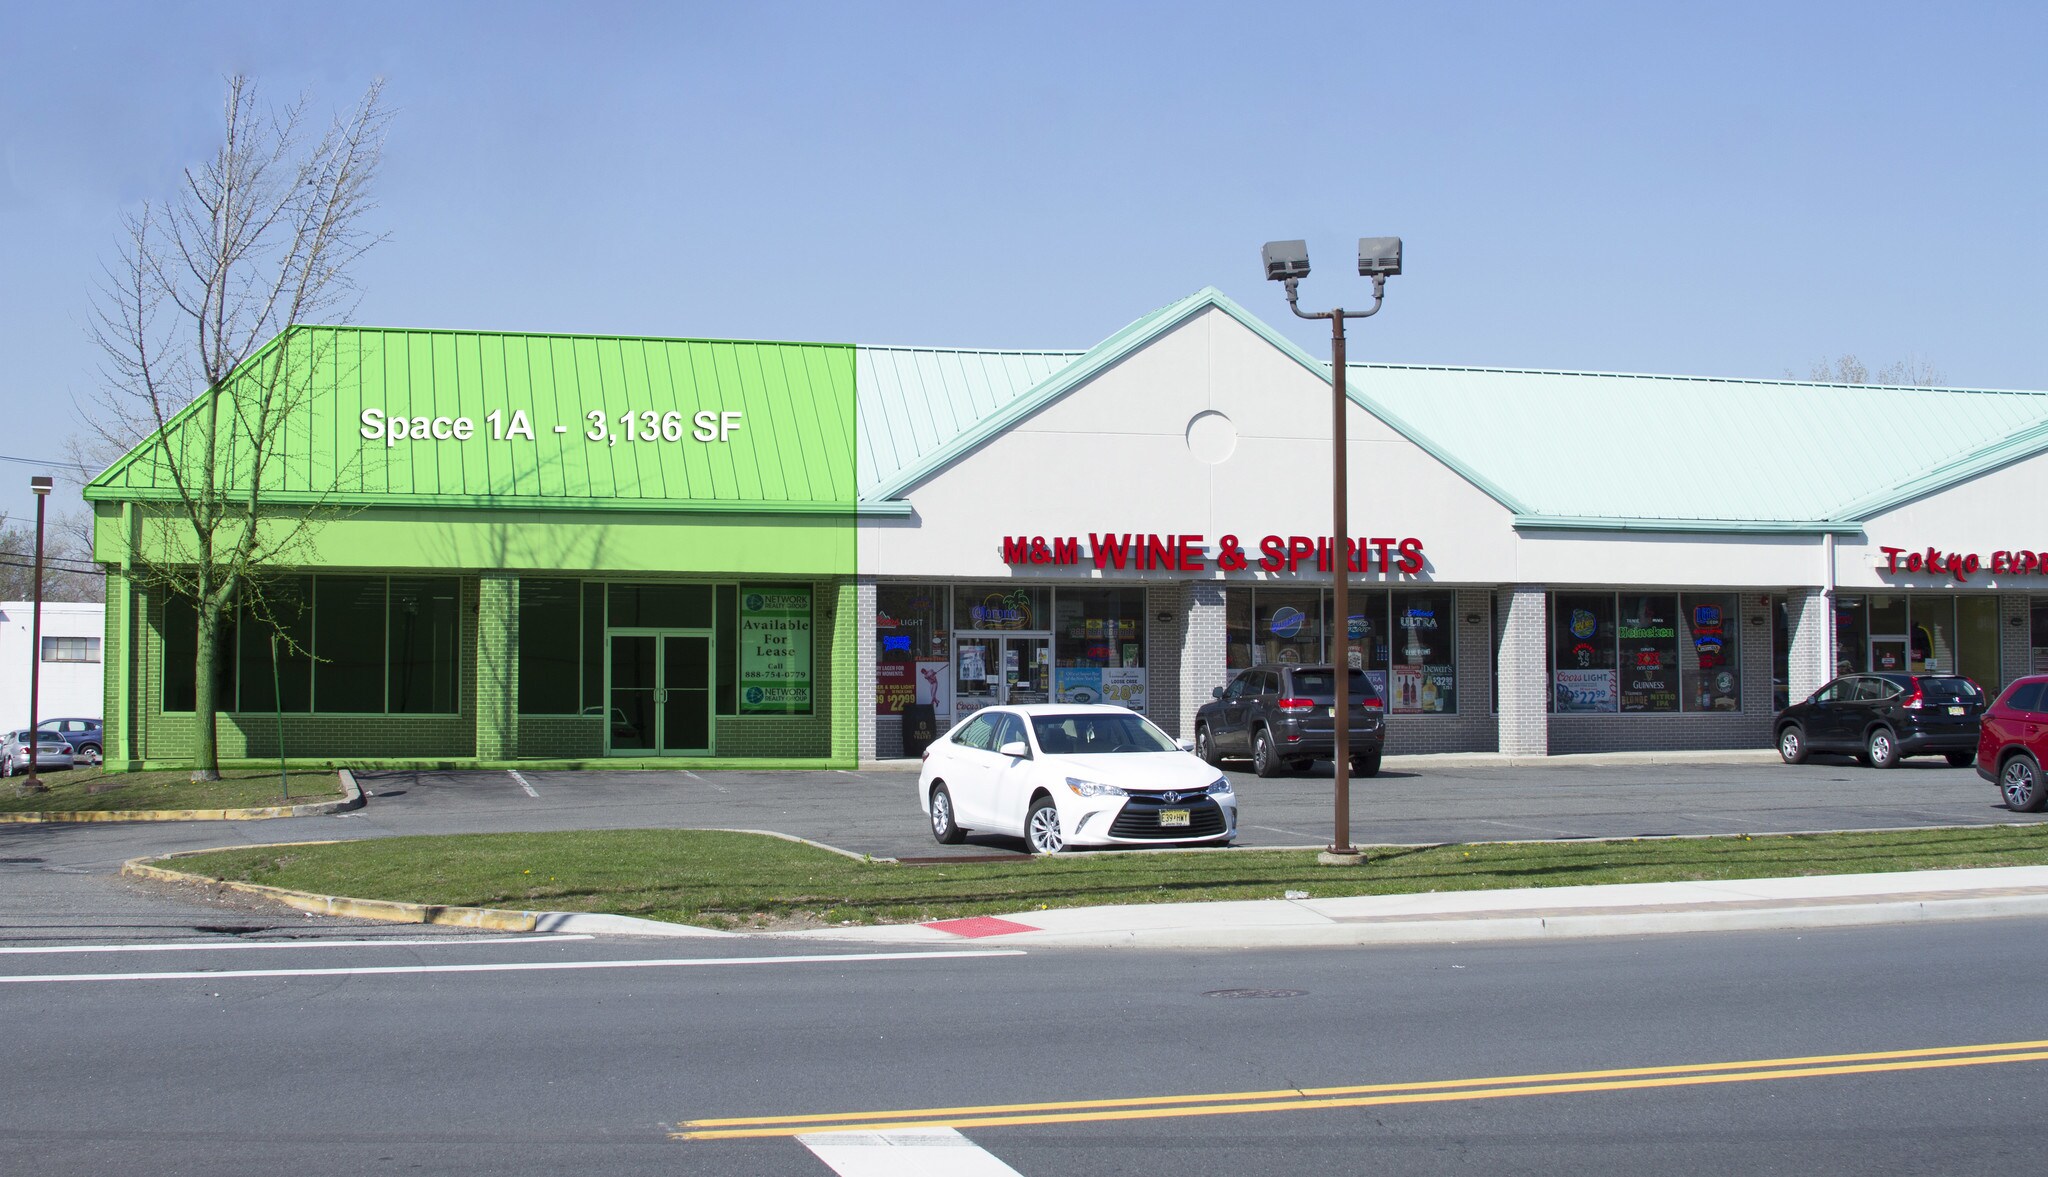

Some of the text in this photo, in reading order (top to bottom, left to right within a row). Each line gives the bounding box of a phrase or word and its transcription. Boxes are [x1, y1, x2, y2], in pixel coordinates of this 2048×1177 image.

[1003, 532, 1424, 574] M&M WINE & SPIRITS
[743, 620, 809, 631] Available
[1400, 617, 1438, 628] ULTRA
[1619, 626, 1674, 639] Heineken
[764, 634, 788, 645] For
[756, 646, 796, 656] Lease
[1423, 664, 1453, 673] Dewar's
[745, 671, 806, 679] 888-754-0779
[1557, 671, 1607, 682] Coors LIGHT
[1632, 680, 1665, 689] GUINNESS
[1621, 695, 1648, 706] BLONDE
